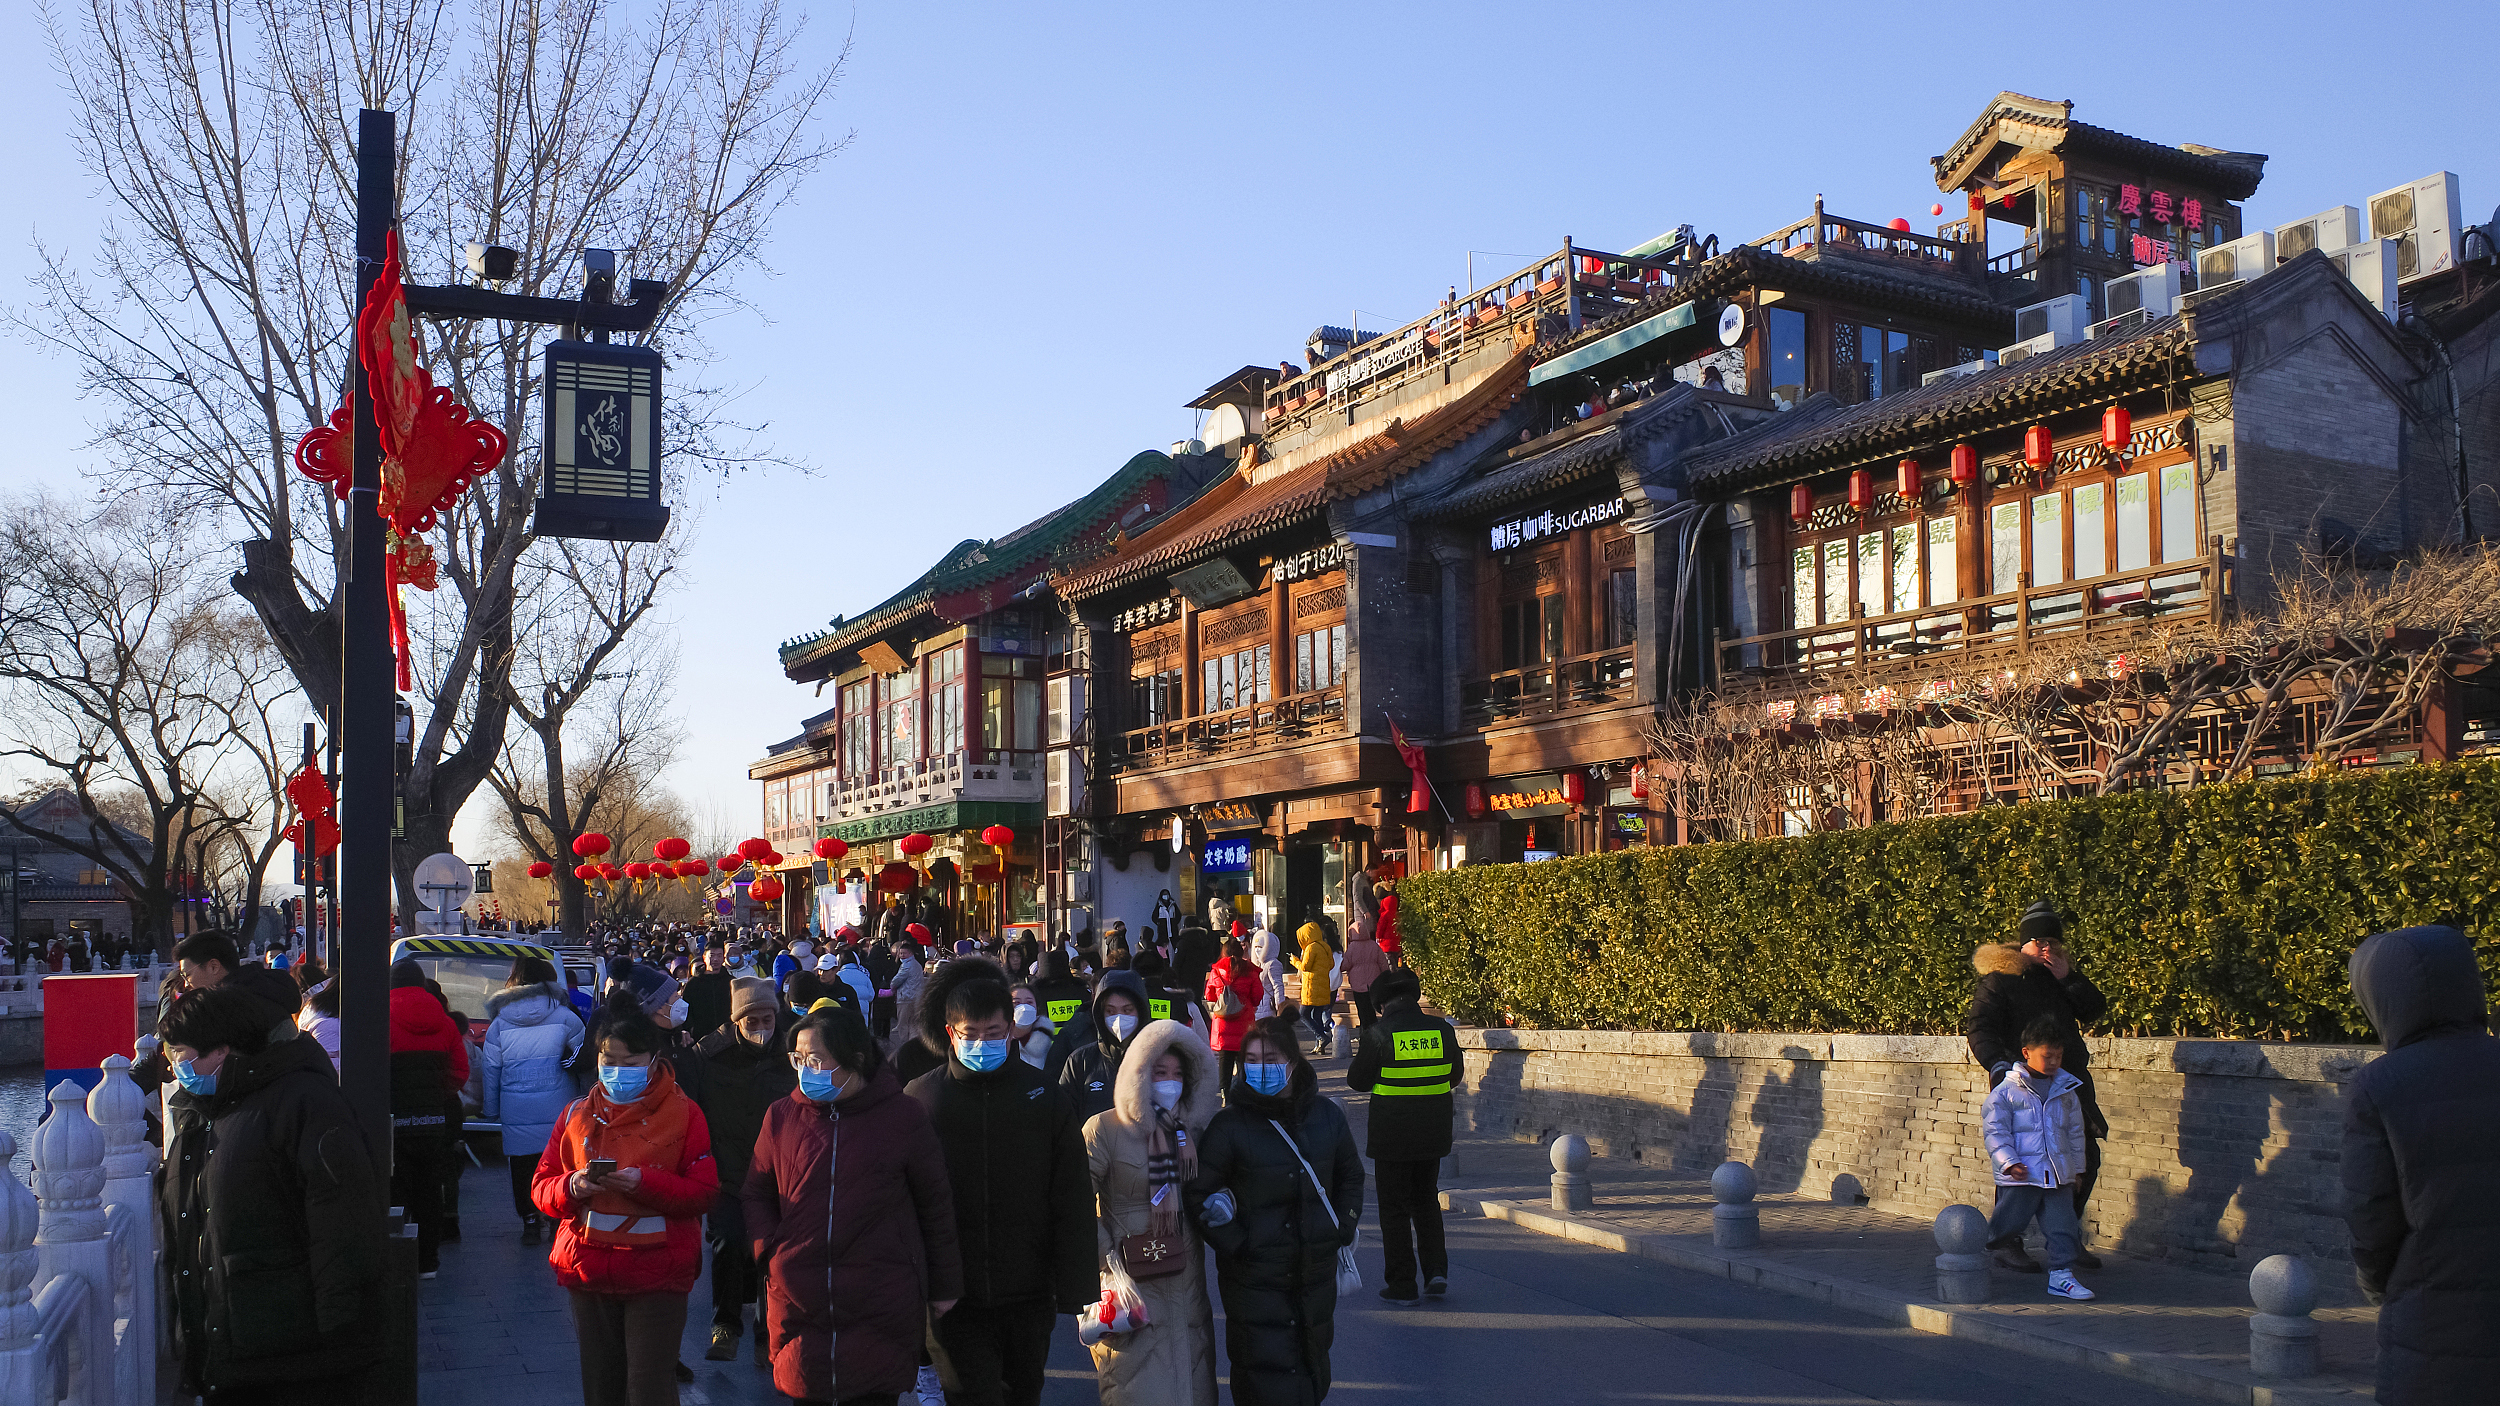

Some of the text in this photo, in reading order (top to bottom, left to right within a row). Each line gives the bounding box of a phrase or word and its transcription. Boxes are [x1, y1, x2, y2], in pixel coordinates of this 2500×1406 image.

[2119, 184, 2203, 230] 慶雲樓
[1994, 468, 2191, 530] 慶雲樓涮肉
[1491, 497, 1624, 552] 糖房咖啡 SUGARBAR
[1272, 544, 1344, 582] 始创于1820
[1112, 597, 1173, 633] 百年老字号
[1150, 1004, 1168, 1014] 欣盛
[1399, 1037, 1440, 1052] 久安欣盛
